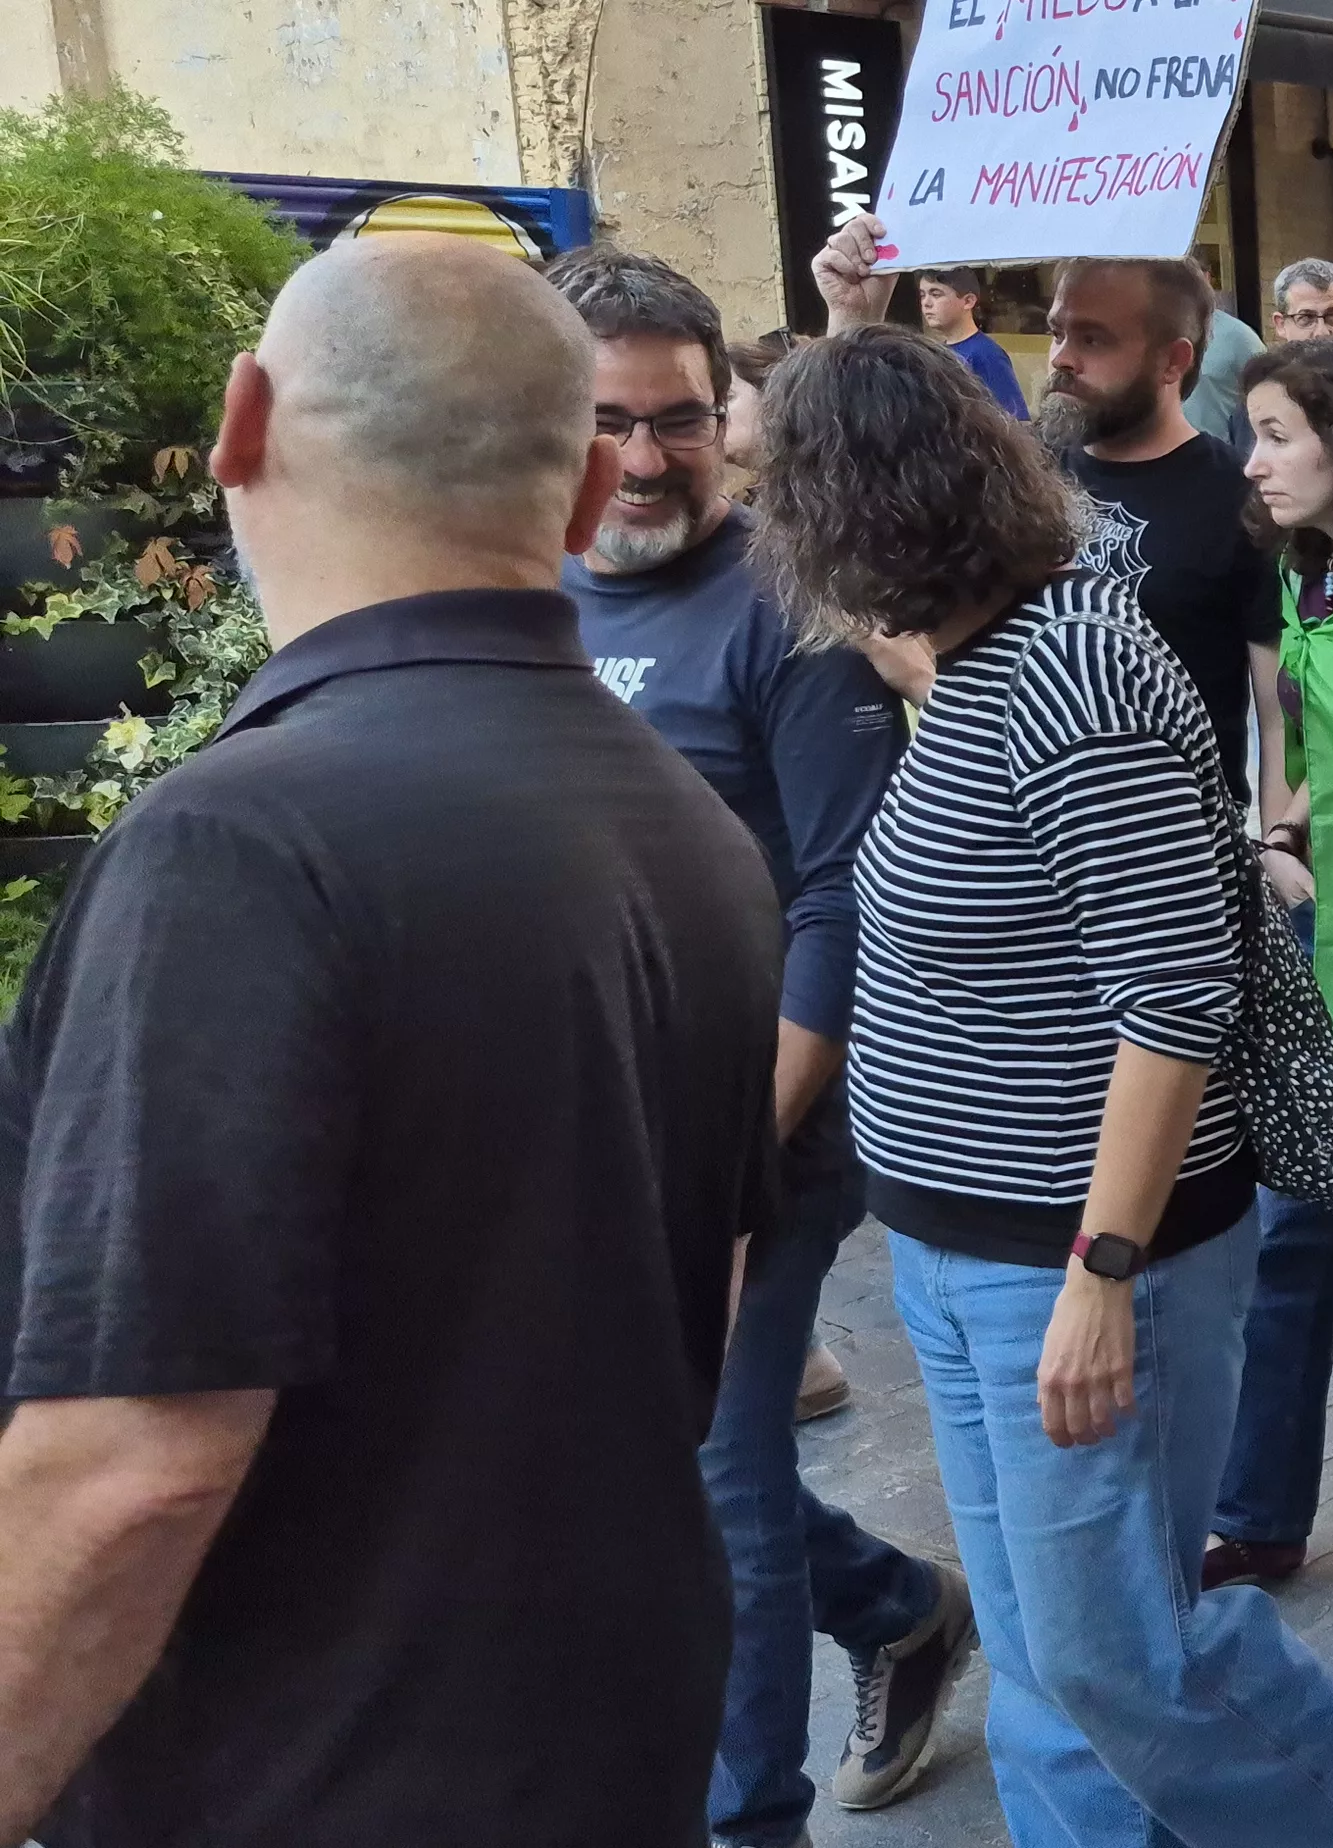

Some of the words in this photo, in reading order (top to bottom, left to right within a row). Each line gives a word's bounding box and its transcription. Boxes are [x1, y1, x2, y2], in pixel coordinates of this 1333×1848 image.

[931, 45, 1081, 122] SANCIÓN
[1094, 67, 1141, 99] NO
[1146, 54, 1235, 98] FRENA
[909, 168, 945, 206] LA
[970, 143, 1203, 207] MANIFESTACIÓN
